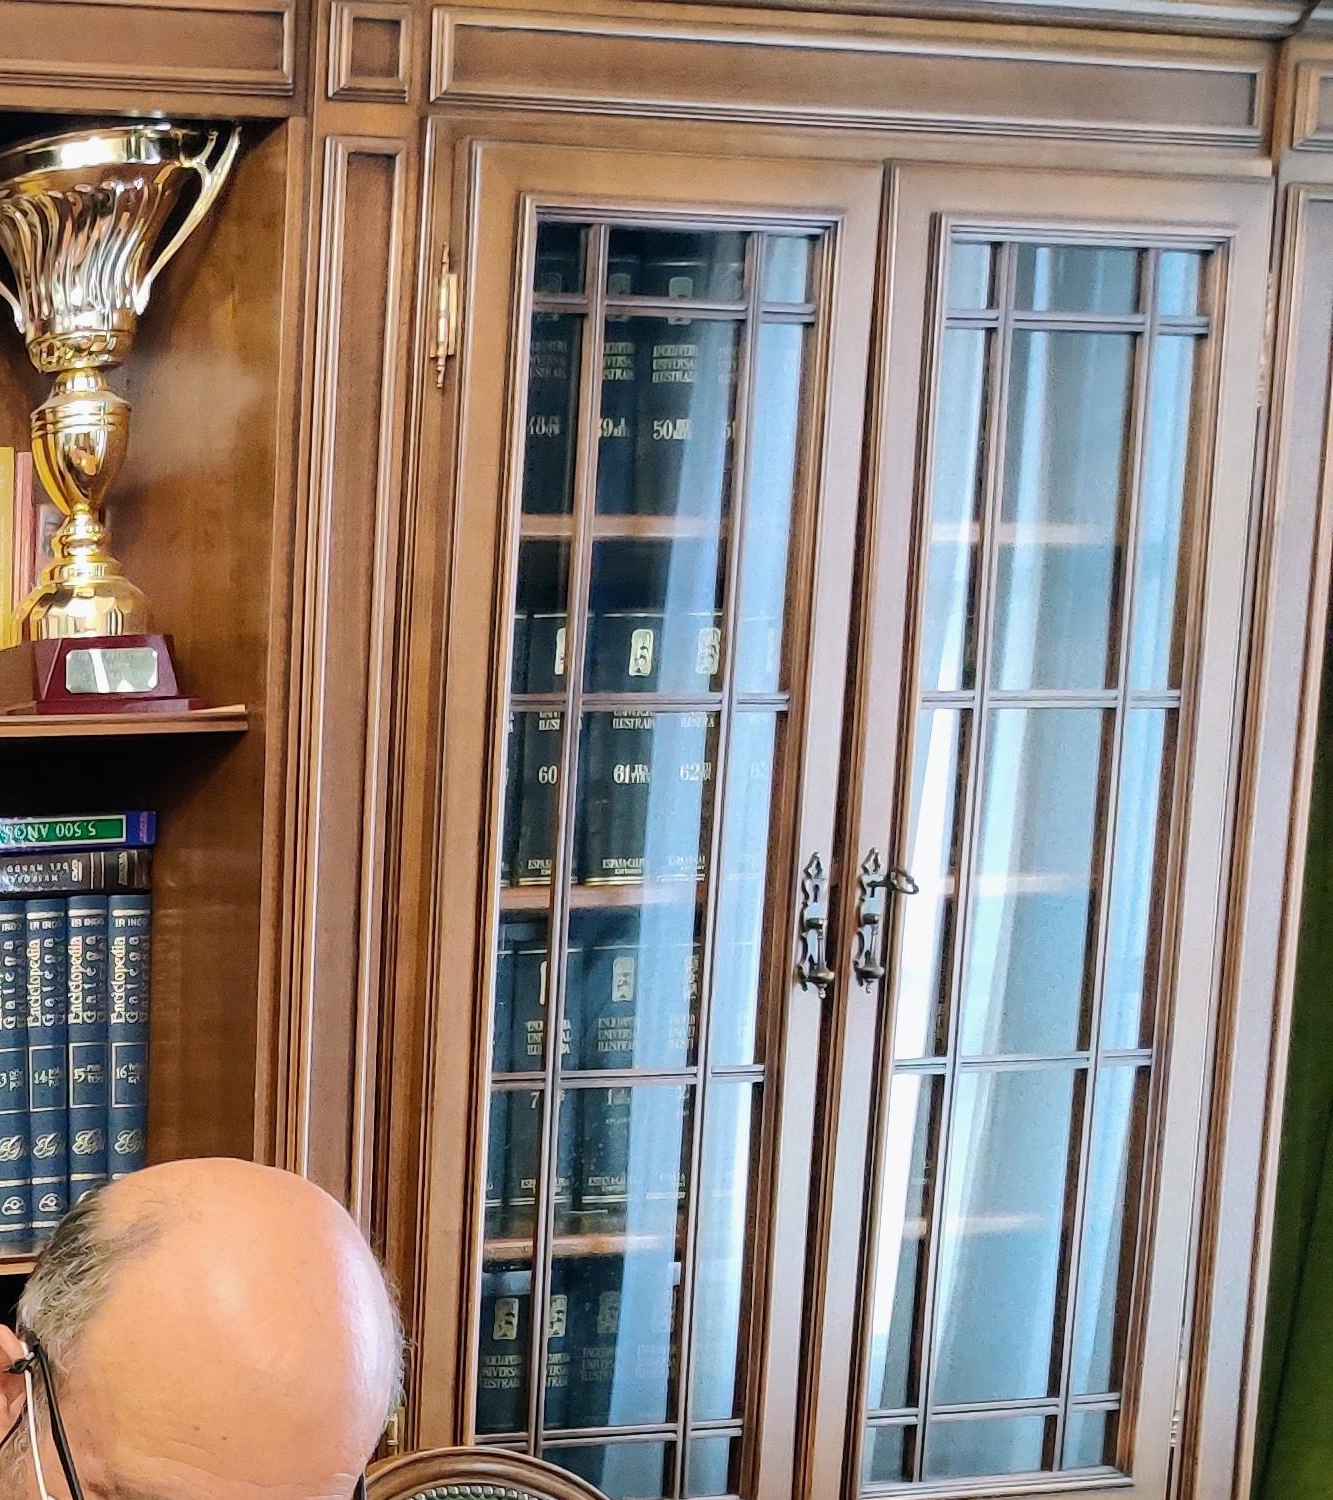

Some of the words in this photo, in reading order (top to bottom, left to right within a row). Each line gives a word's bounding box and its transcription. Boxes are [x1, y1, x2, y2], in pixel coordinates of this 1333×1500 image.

[652, 418, 674, 441] 50
[537, 765, 559, 785] 60
[613, 764, 630, 785] 61
[55, 821, 98, 838] 5.500
[26, 937, 47, 1029] Enciclopedia
[67, 935, 87, 1025] Enciclopedia
[110, 936, 131, 1026] Enciclopedia
